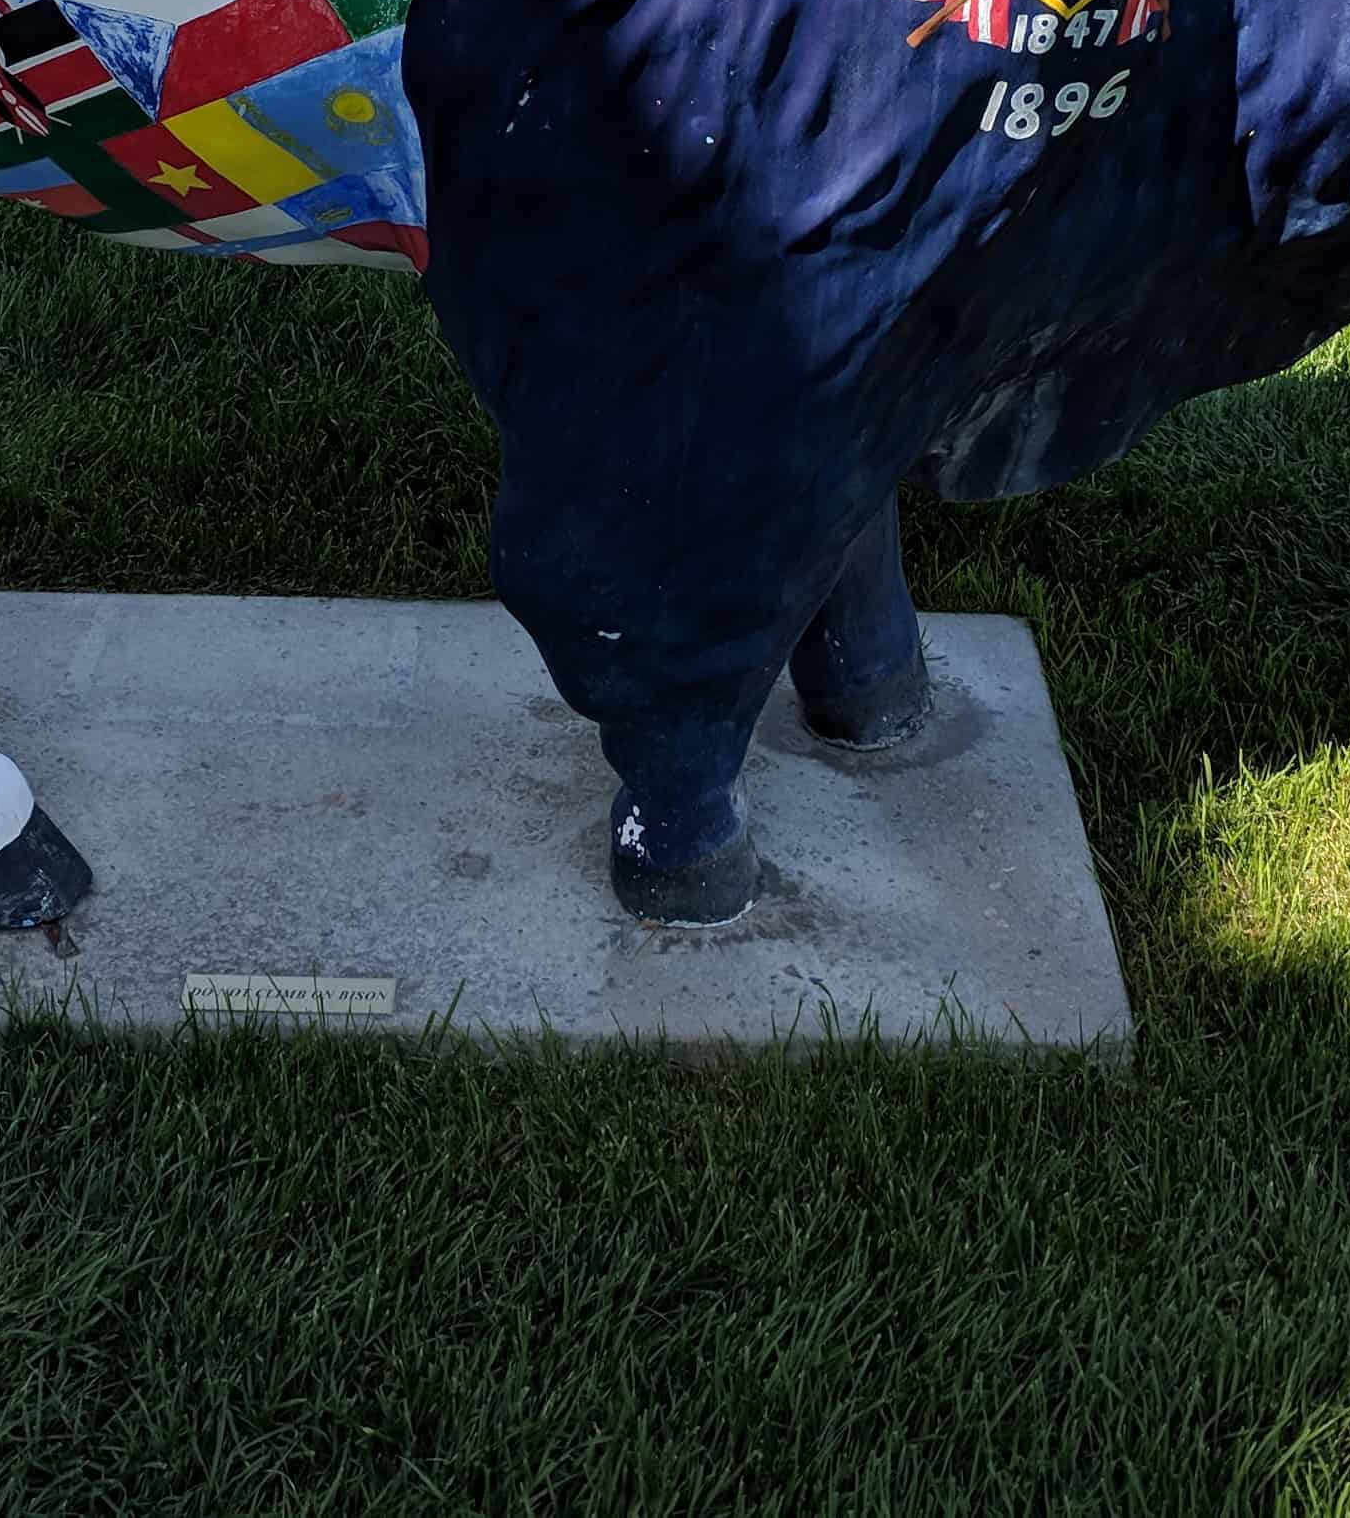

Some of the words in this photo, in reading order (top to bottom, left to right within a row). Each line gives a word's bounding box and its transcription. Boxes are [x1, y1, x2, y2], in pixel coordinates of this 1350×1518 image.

[1010, 8, 1119, 55] 1847
[979, 68, 1131, 140] 1896
[191, 986, 214, 997] DO
[221, 986, 253, 997] NOT
[338, 990, 388, 1001] BISON
